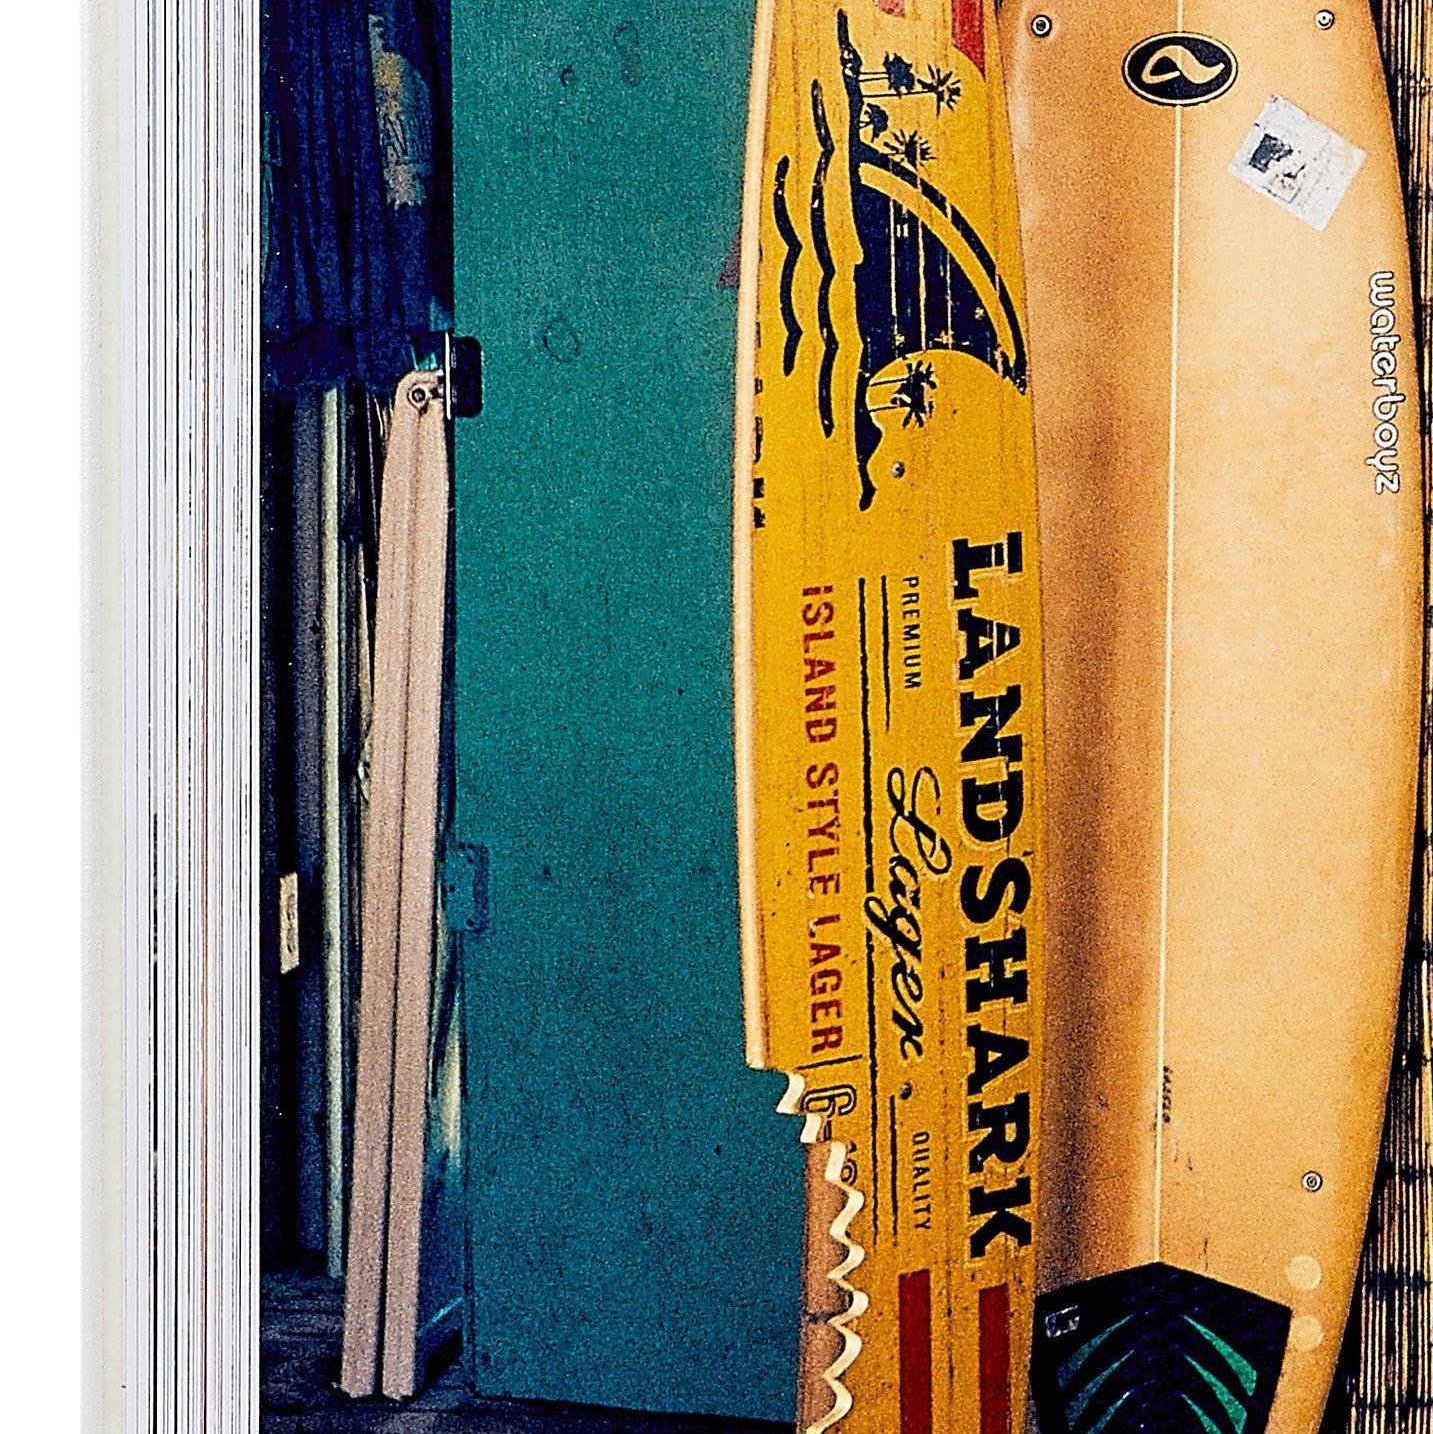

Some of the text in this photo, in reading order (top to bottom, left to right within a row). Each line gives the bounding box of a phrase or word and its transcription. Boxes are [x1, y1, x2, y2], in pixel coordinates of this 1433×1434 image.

[1364, 271, 1407, 496] waterboyz
[801, 584, 838, 744] ISLAND
[901, 576, 922, 691] PREMIUM
[806, 764, 844, 897] STYLE
[952, 531, 1033, 1258] LANDSHARK
[809, 916, 847, 1054] LAGER
[864, 766, 952, 1061] Lager
[911, 1131, 932, 1231] QUALITY
